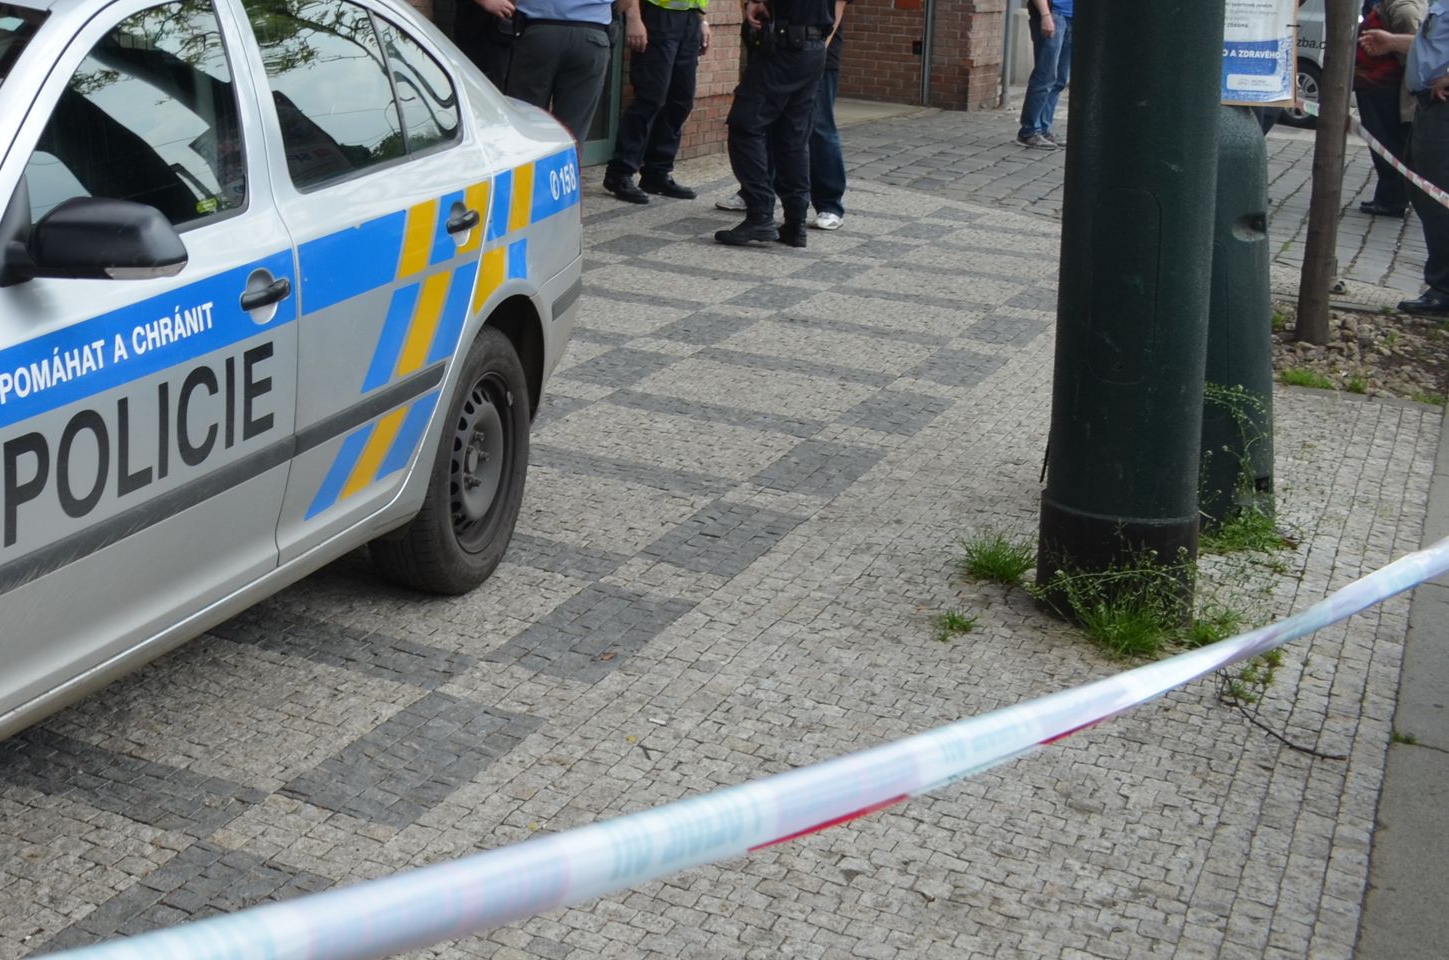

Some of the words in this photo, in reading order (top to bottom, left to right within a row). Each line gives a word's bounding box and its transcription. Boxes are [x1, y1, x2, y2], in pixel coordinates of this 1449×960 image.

[1238, 49, 1281, 60] ZDRAVÉHO
[559, 162, 577, 196] 158
[113, 333, 129, 364] A
[131, 301, 214, 355] CHRÁNIT
[2, 340, 275, 549] POLICIE
